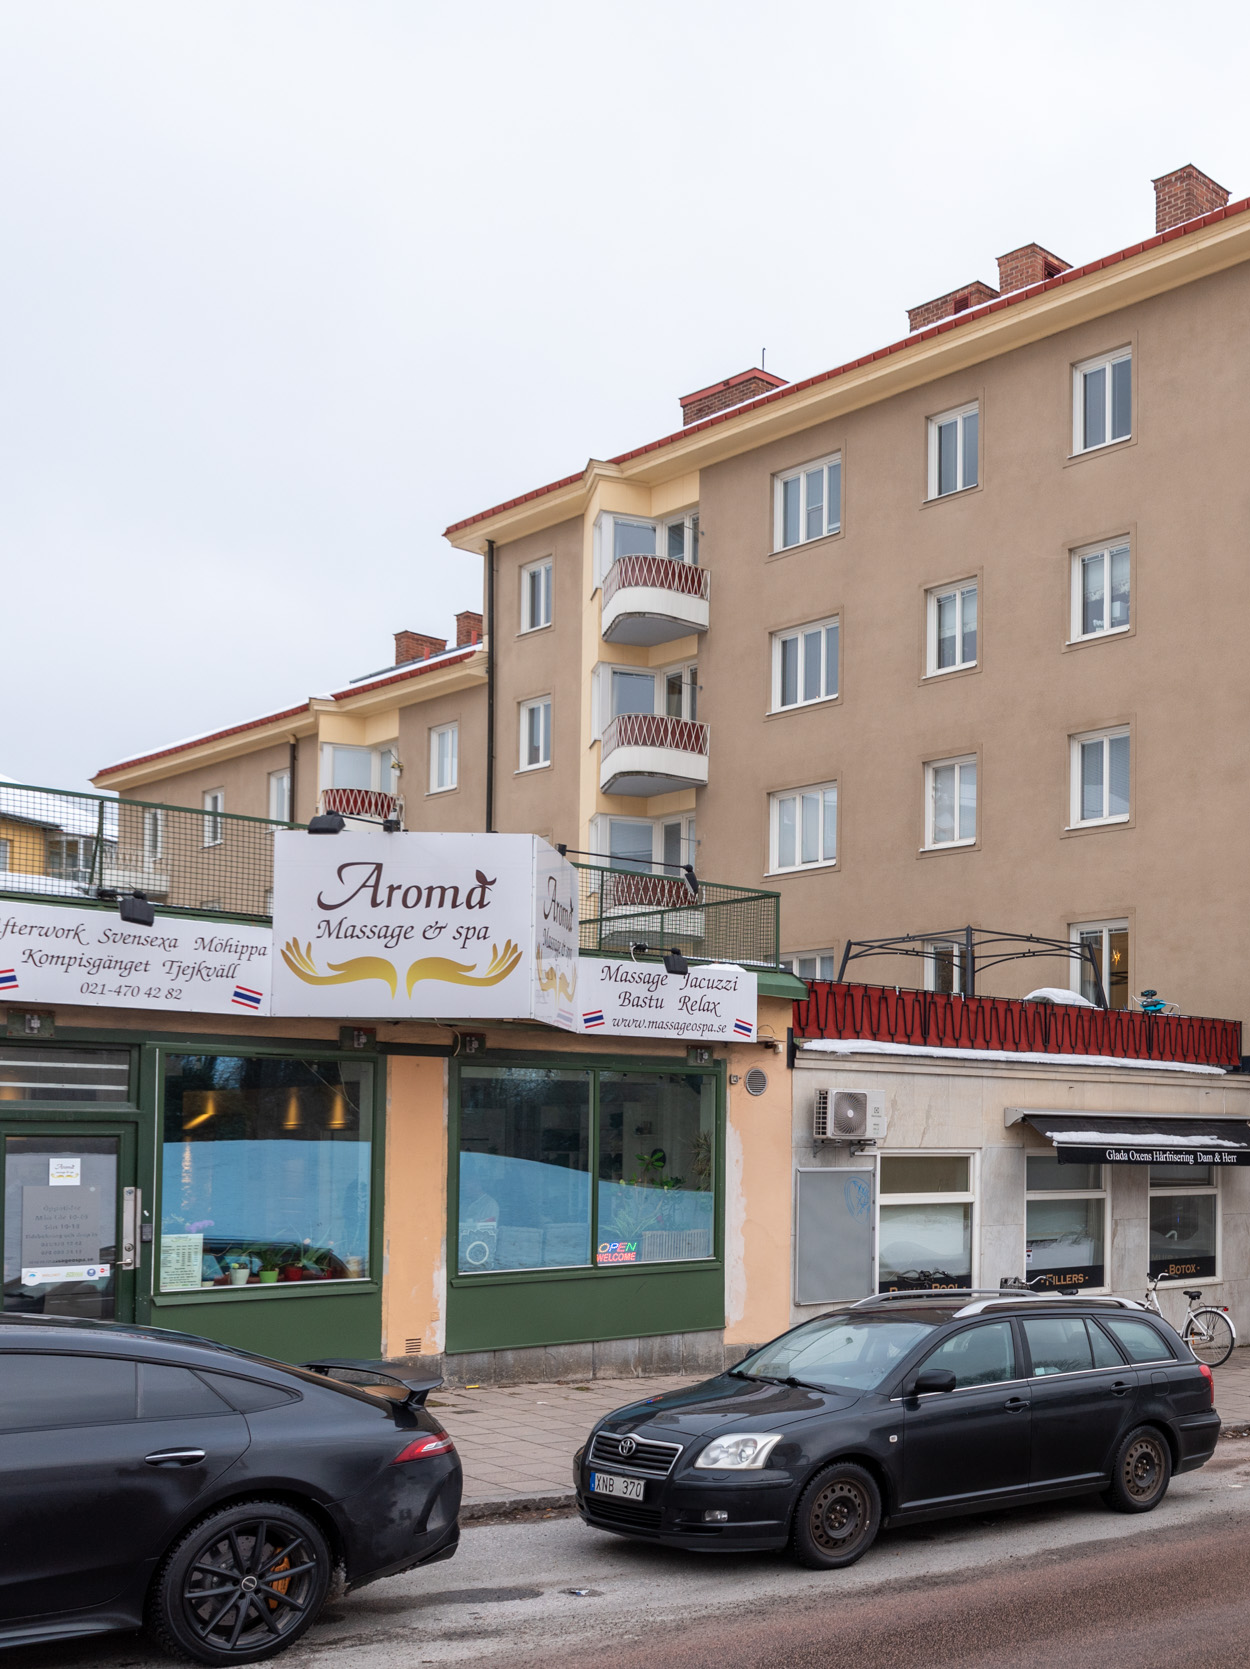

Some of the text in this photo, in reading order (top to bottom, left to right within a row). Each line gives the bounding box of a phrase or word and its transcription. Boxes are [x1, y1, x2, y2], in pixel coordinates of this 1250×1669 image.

[317, 862, 497, 911] Aroma
[0, 917, 268, 961] fterwork Svensexa Möhippa
[316, 917, 491, 949] Massage & spa
[21, 948, 240, 983] Kompisgänget Tjejkväll
[600, 964, 739, 992] Massage Jacuzzi
[80, 981, 182, 1000] 021-470 42 82
[618, 991, 722, 1017] Bastu Relax
[612, 1017, 727, 1037] www.massageospa.se
[1106, 1150, 1237, 1164] Glada Oxens Hårfrisering Dam & Herr
[596, 1252, 636, 1263] WELCOME
[599, 1242, 637, 1253] OPEN
[596, 1474, 642, 1497] XNB 370
